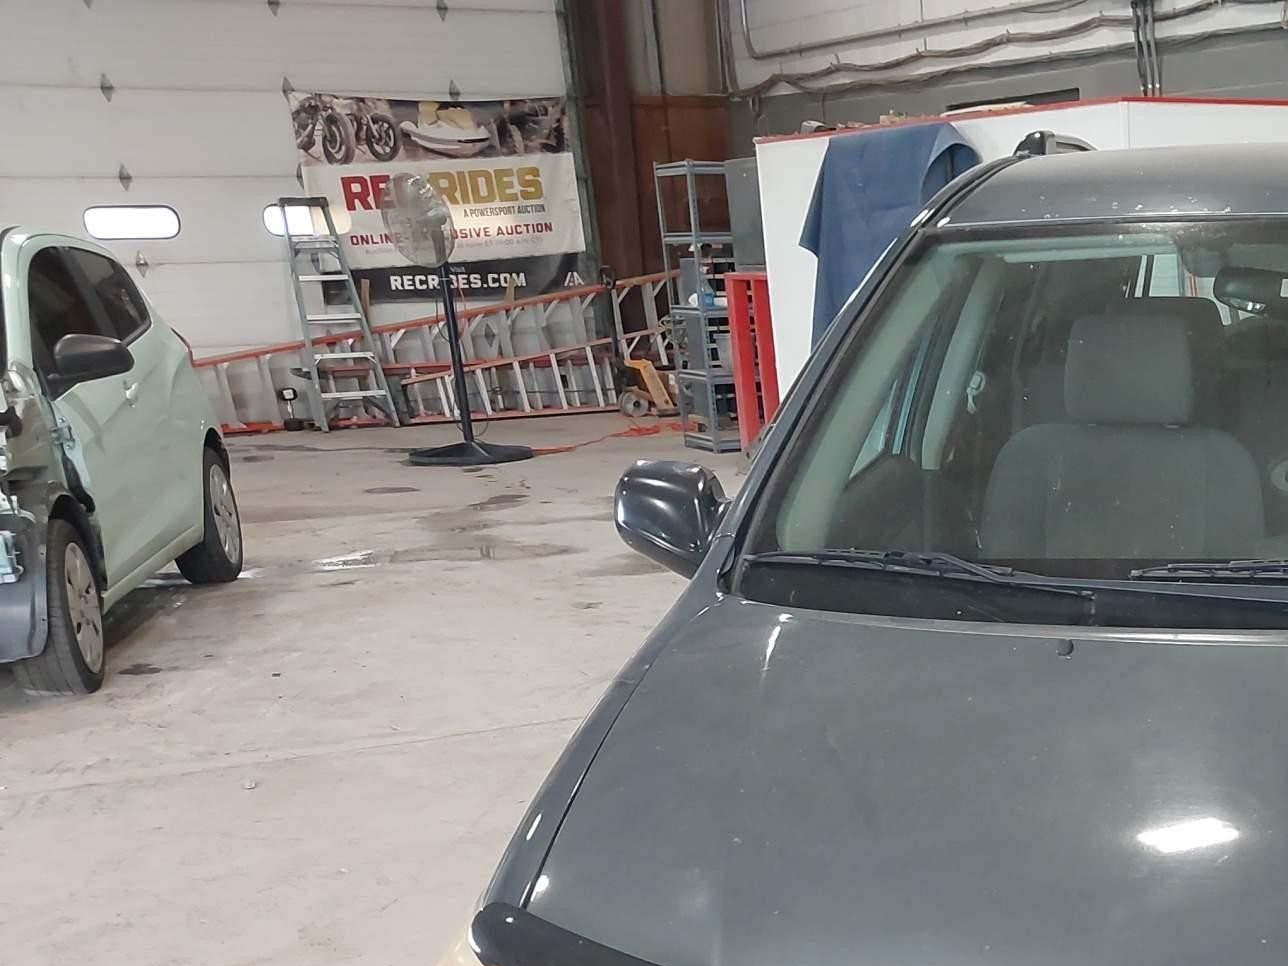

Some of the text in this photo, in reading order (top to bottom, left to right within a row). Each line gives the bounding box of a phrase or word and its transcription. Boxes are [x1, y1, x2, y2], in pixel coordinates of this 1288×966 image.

[340, 166, 544, 211] RERIDES
[463, 203, 546, 218] A POWERSPORT AUCTION
[496, 221, 553, 237] AUCTION
[389, 272, 527, 290] RECRDES.COM
